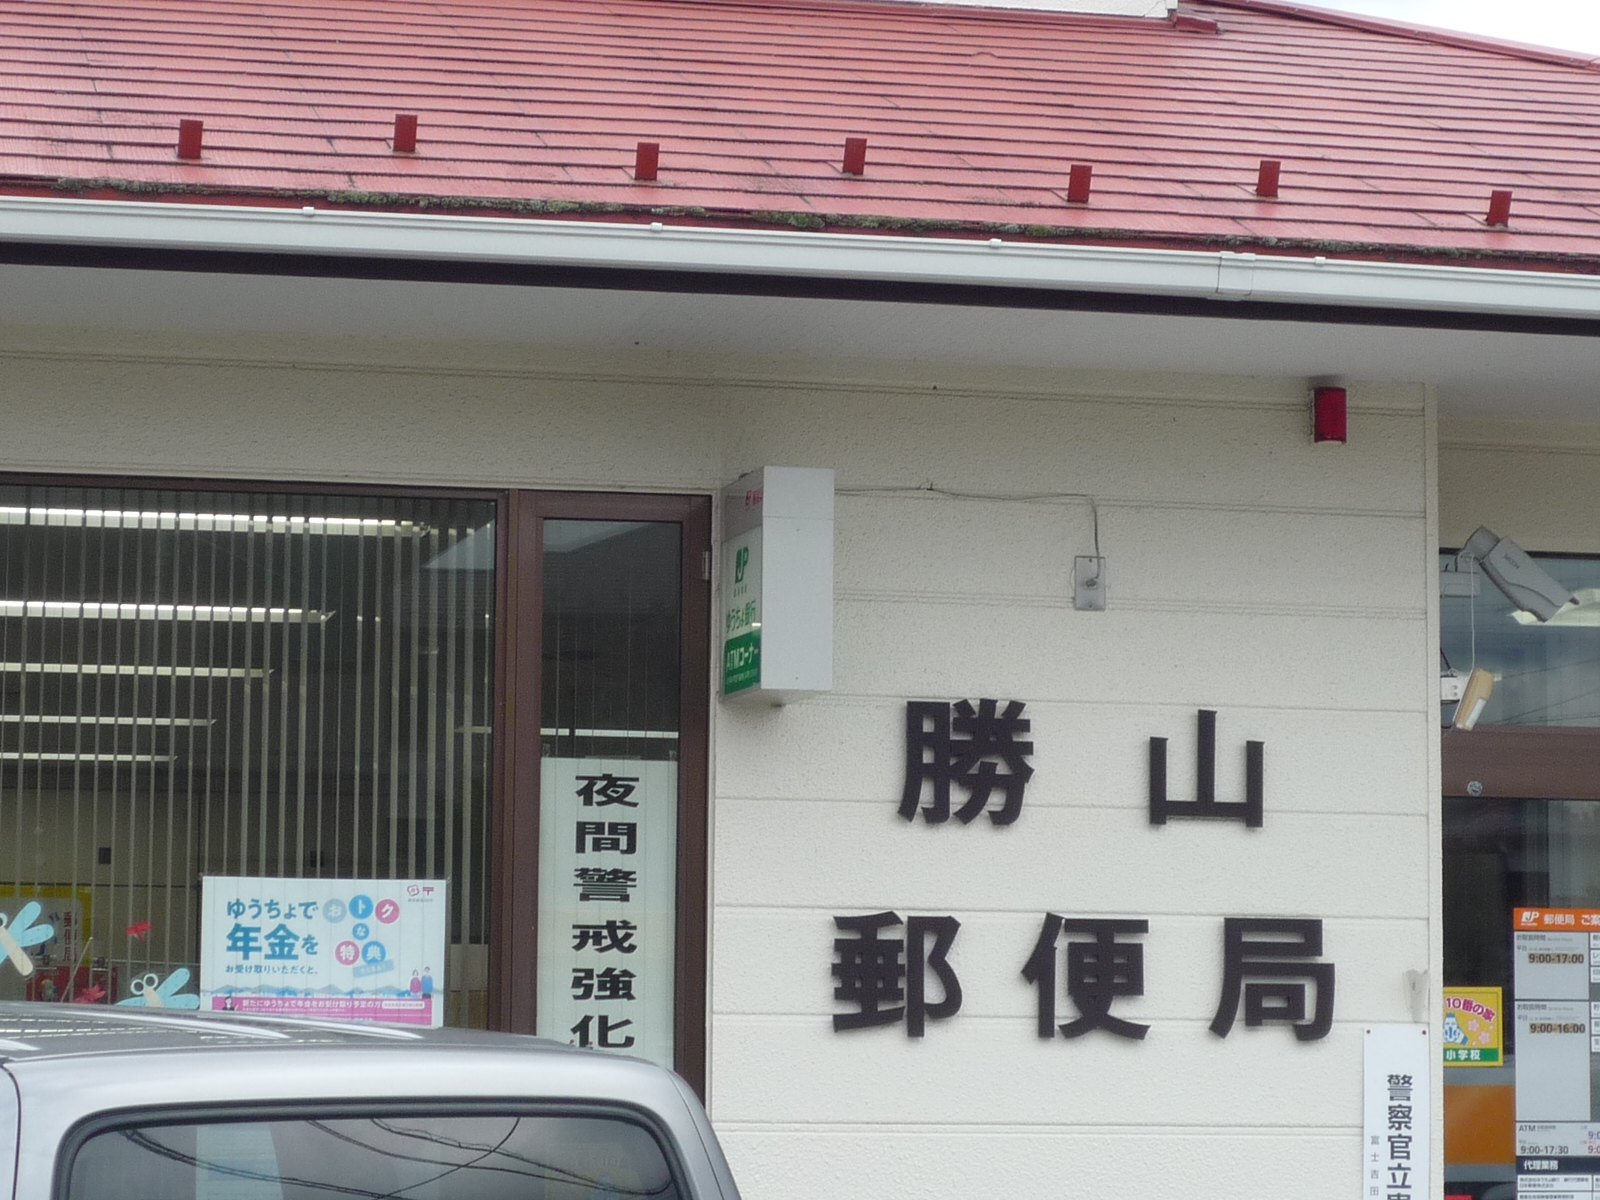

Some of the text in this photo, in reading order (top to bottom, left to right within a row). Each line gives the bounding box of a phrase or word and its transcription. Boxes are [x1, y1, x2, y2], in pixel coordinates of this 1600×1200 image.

[898, 698, 1265, 828] 勝山
[226, 898, 319, 920] ゆうちょで
[569, 773, 640, 1050] 夜間警戒強化
[225, 922, 319, 961] 年金を
[1529, 953, 1585, 964] 9:00-17:00
[830, 910, 1336, 1042] 郵便局
[1529, 1023, 1586, 1034] 9:00-16:00
[1446, 1049, 1480, 1061] 小学校
[1519, 1123, 1536, 1132] ATM
[1520, 1145, 1569, 1154] 9:00-17:30
[1370, 1135, 1380, 1197] 富士吉田
